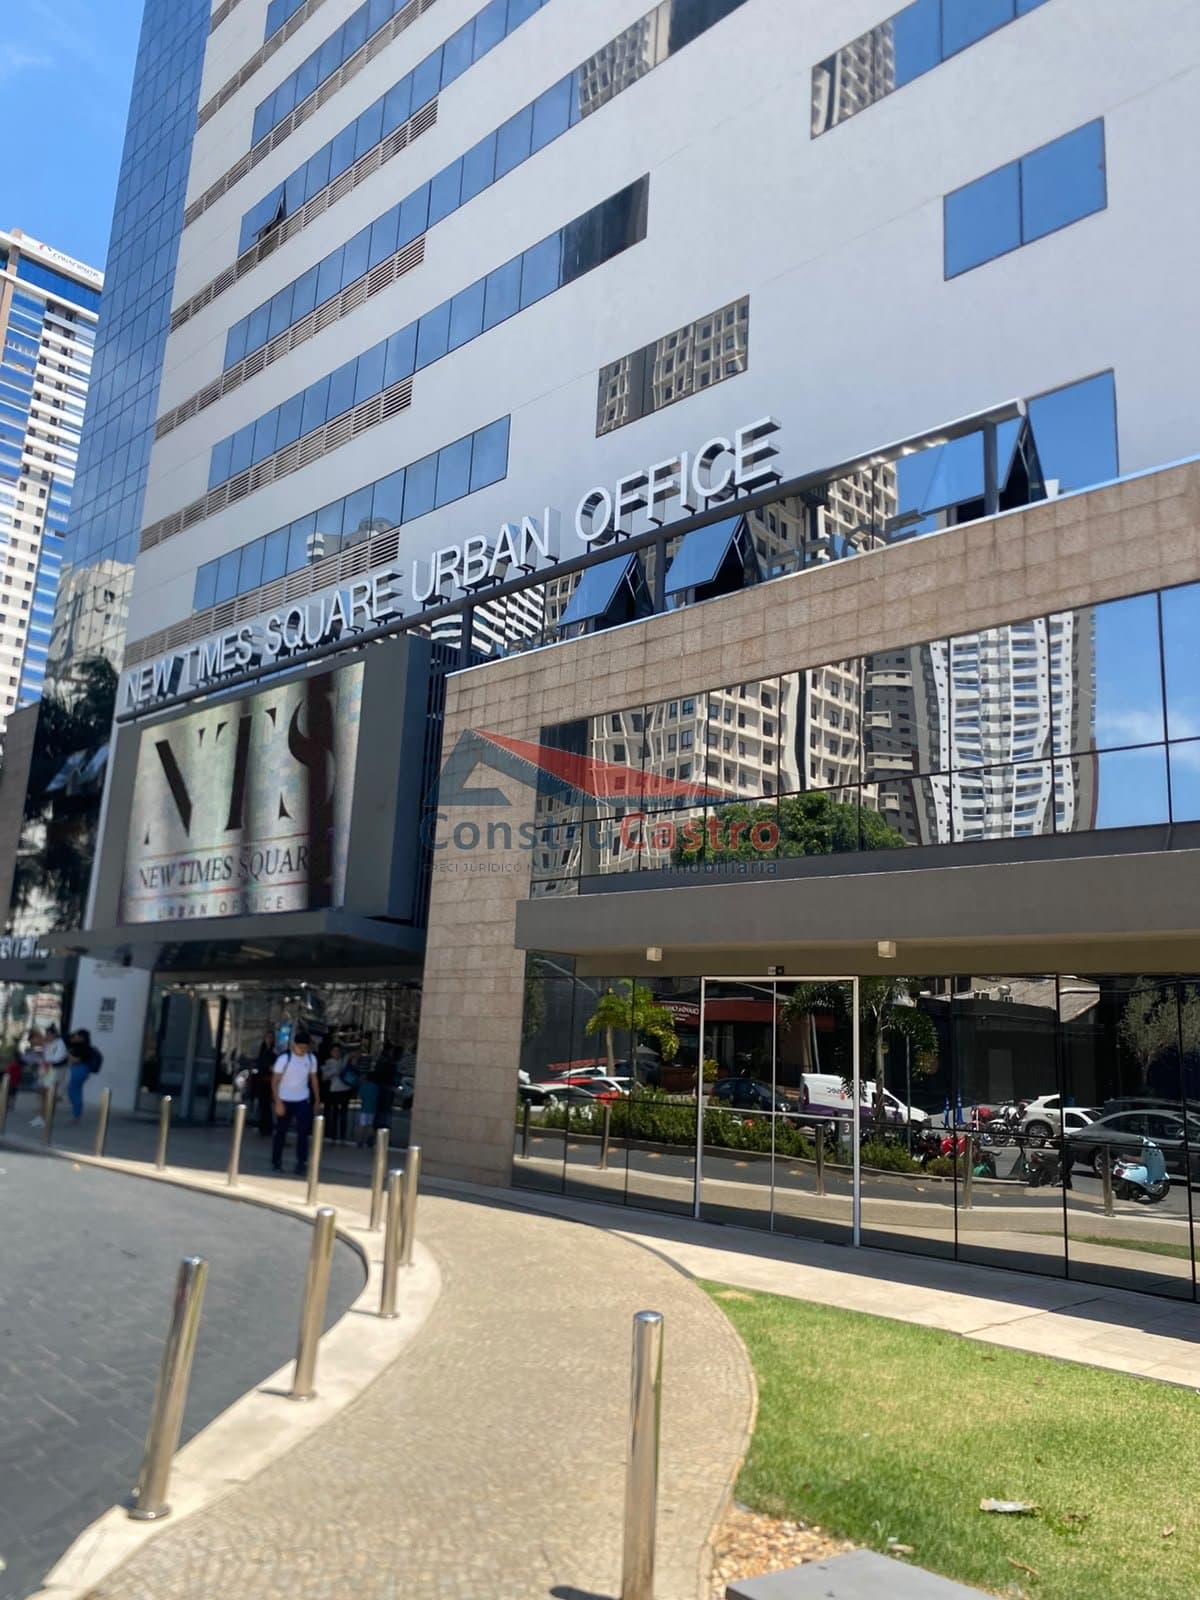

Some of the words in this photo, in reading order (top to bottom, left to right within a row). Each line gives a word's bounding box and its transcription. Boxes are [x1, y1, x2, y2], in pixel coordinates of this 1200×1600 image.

[126, 658, 183, 708] NEW
[185, 625, 261, 684] TIMES
[264, 569, 403, 653] SQUARE
[411, 505, 561, 603] URBAN
[575, 415, 782, 545] OFFICE
[137, 865, 176, 892] NEW
[177, 855, 234, 885] TIMES
